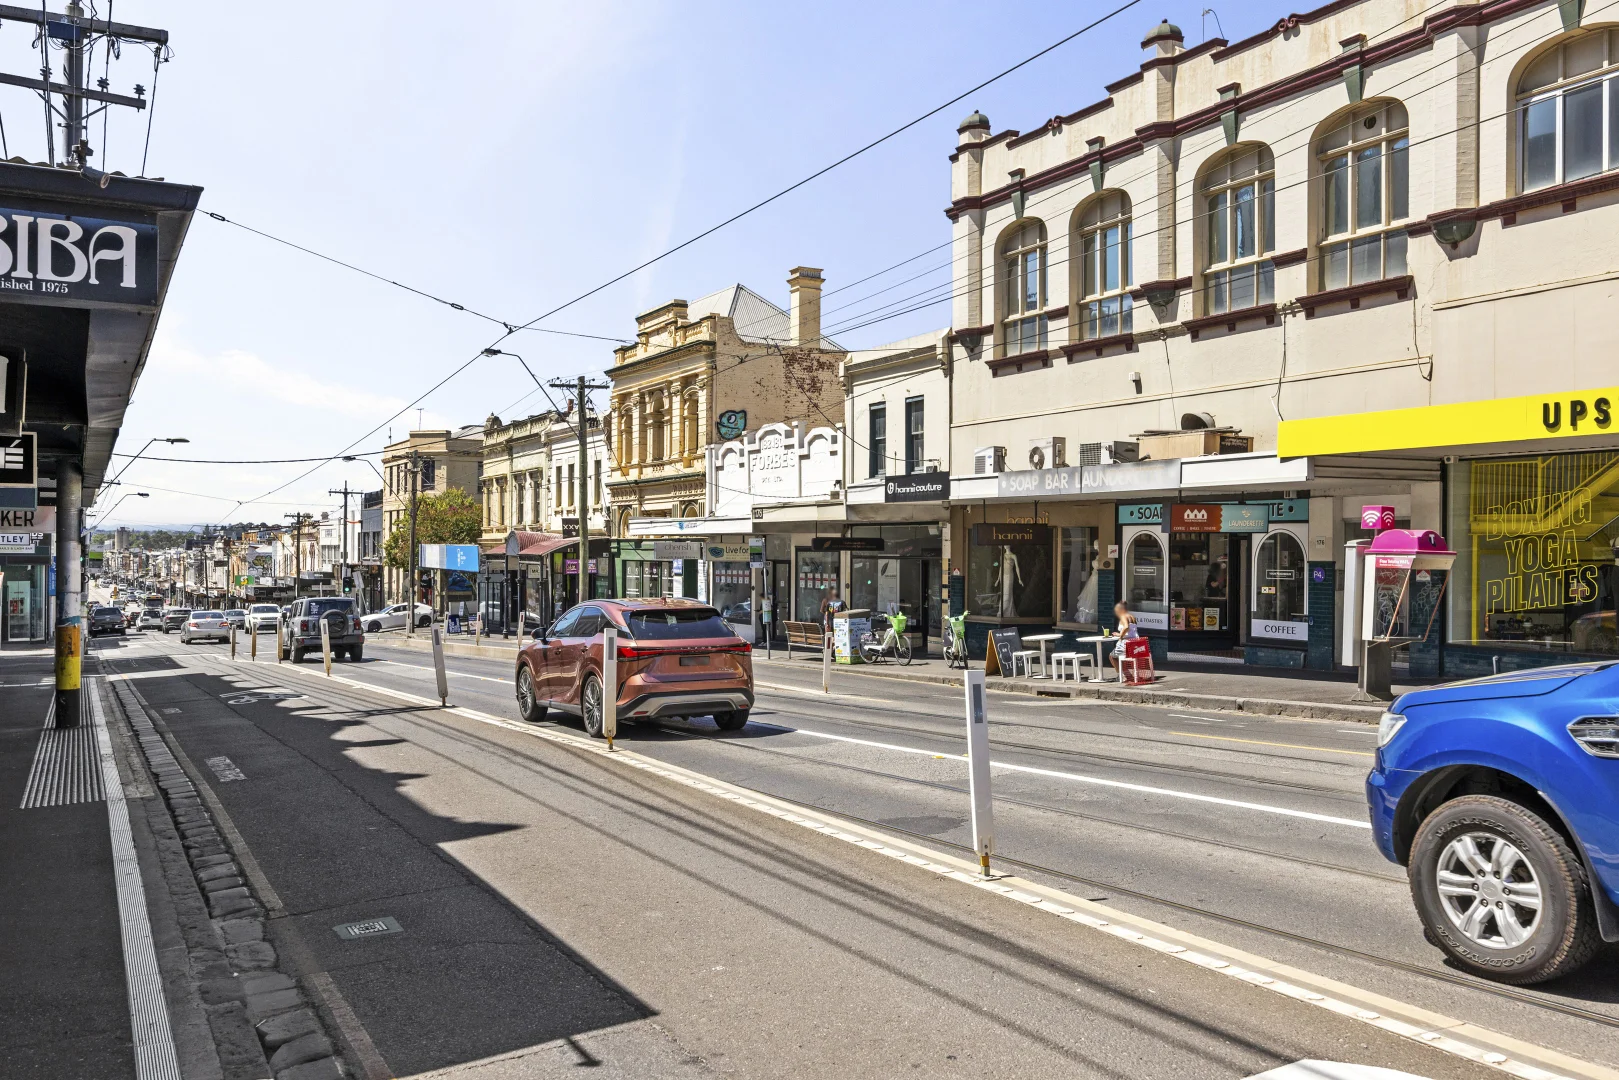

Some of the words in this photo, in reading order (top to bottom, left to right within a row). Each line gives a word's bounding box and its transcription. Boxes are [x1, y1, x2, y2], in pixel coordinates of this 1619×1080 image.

[0, 214, 138, 289] IBA
[40, 281, 69, 294] 1975
[751, 451, 796, 472] FORBES
[916, 482, 943, 492] couture
[1009, 475, 1039, 492] SOAP
[1045, 472, 1069, 490] BAR
[1486, 488, 1592, 542] BOXING
[993, 526, 1033, 540] hannii
[725, 546, 738, 554] Live
[1504, 529, 1579, 575] YOGA
[1486, 565, 1598, 615] PILATES
[1264, 624, 1297, 635] COFFEE
[1436, 924, 1537, 967] GOODYEAR
